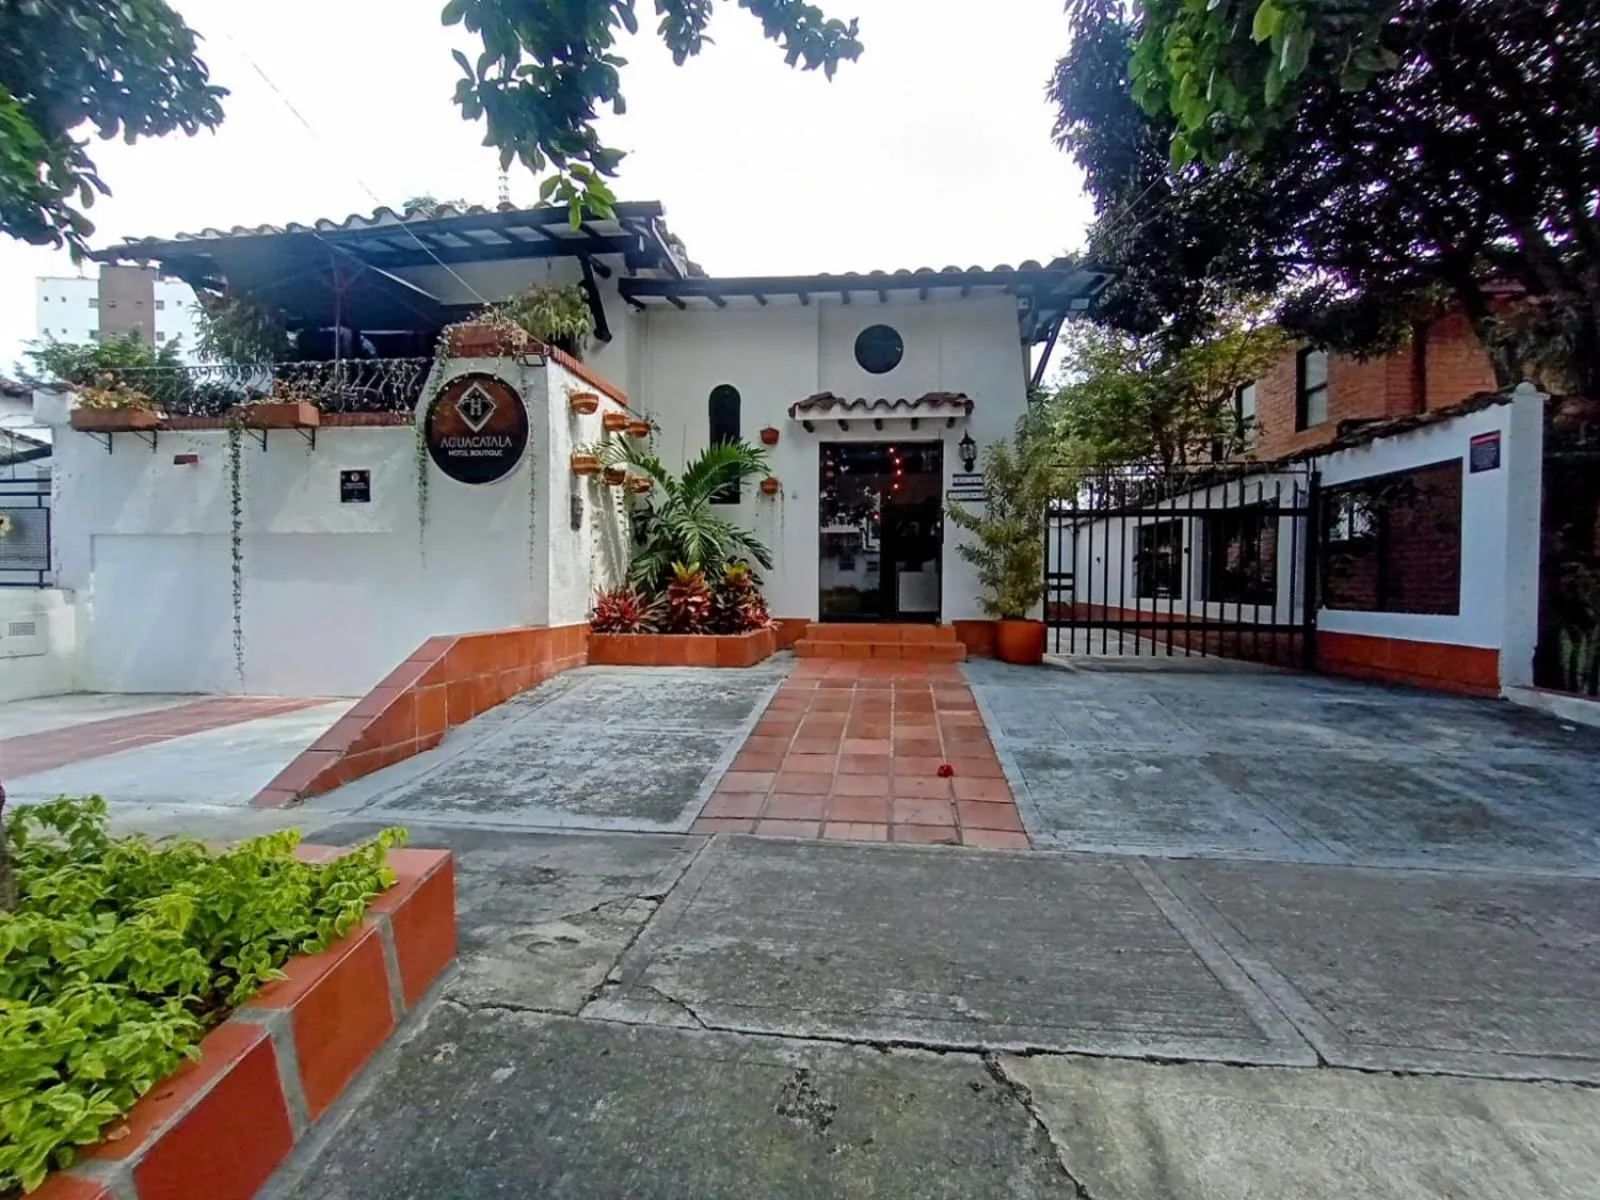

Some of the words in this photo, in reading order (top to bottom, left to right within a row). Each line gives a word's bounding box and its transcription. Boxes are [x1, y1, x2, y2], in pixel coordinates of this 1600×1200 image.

[440, 435, 513, 448] AGUACATALA
[448, 449, 469, 457] HOTEL
[470, 449, 504, 457] BOUTIQUE
